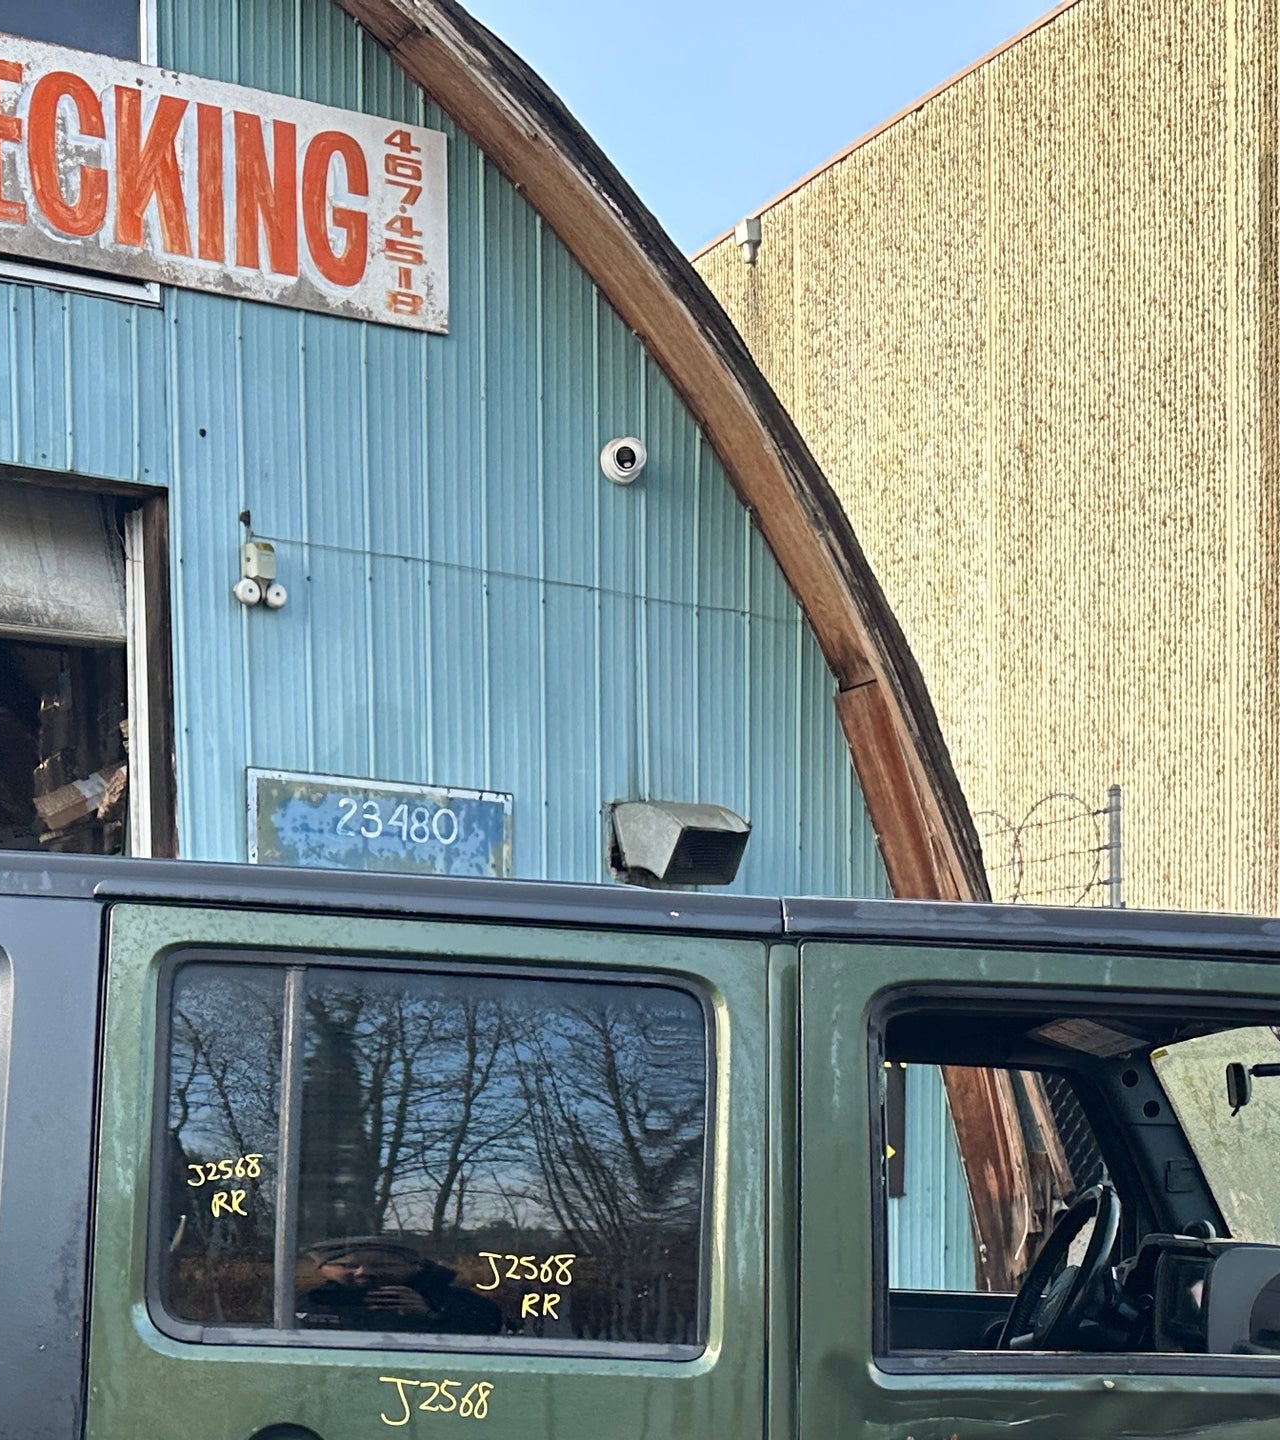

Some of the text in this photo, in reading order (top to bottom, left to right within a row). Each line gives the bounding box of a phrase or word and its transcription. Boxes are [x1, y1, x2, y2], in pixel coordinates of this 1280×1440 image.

[336, 797, 459, 845] 23480
[186, 1152, 264, 1187] J2568
[210, 1189, 248, 1218] RR
[475, 1251, 577, 1291] J2568
[520, 1292, 561, 1320] RR
[378, 1376, 495, 1426] J2568
